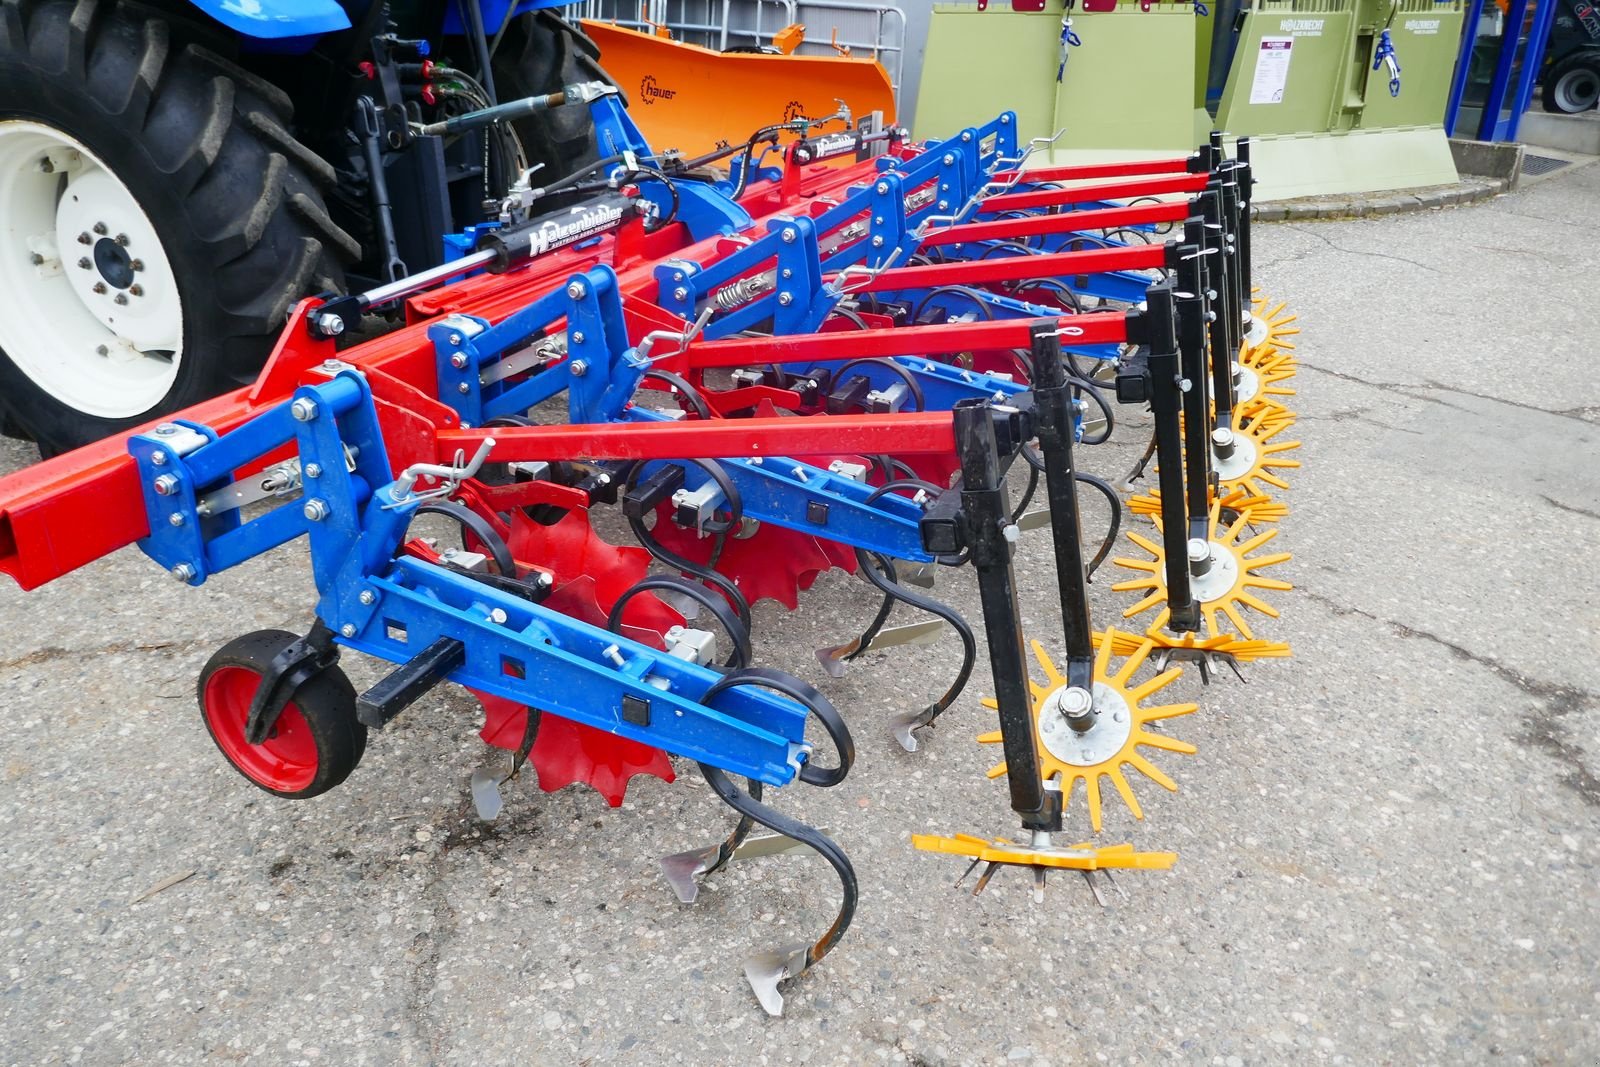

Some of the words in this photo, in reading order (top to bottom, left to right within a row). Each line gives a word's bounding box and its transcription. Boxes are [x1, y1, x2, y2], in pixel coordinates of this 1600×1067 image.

[1574, 3, 1600, 39] GIANT
[646, 82, 676, 100] hauer
[529, 204, 624, 258] Hatzenbichler
